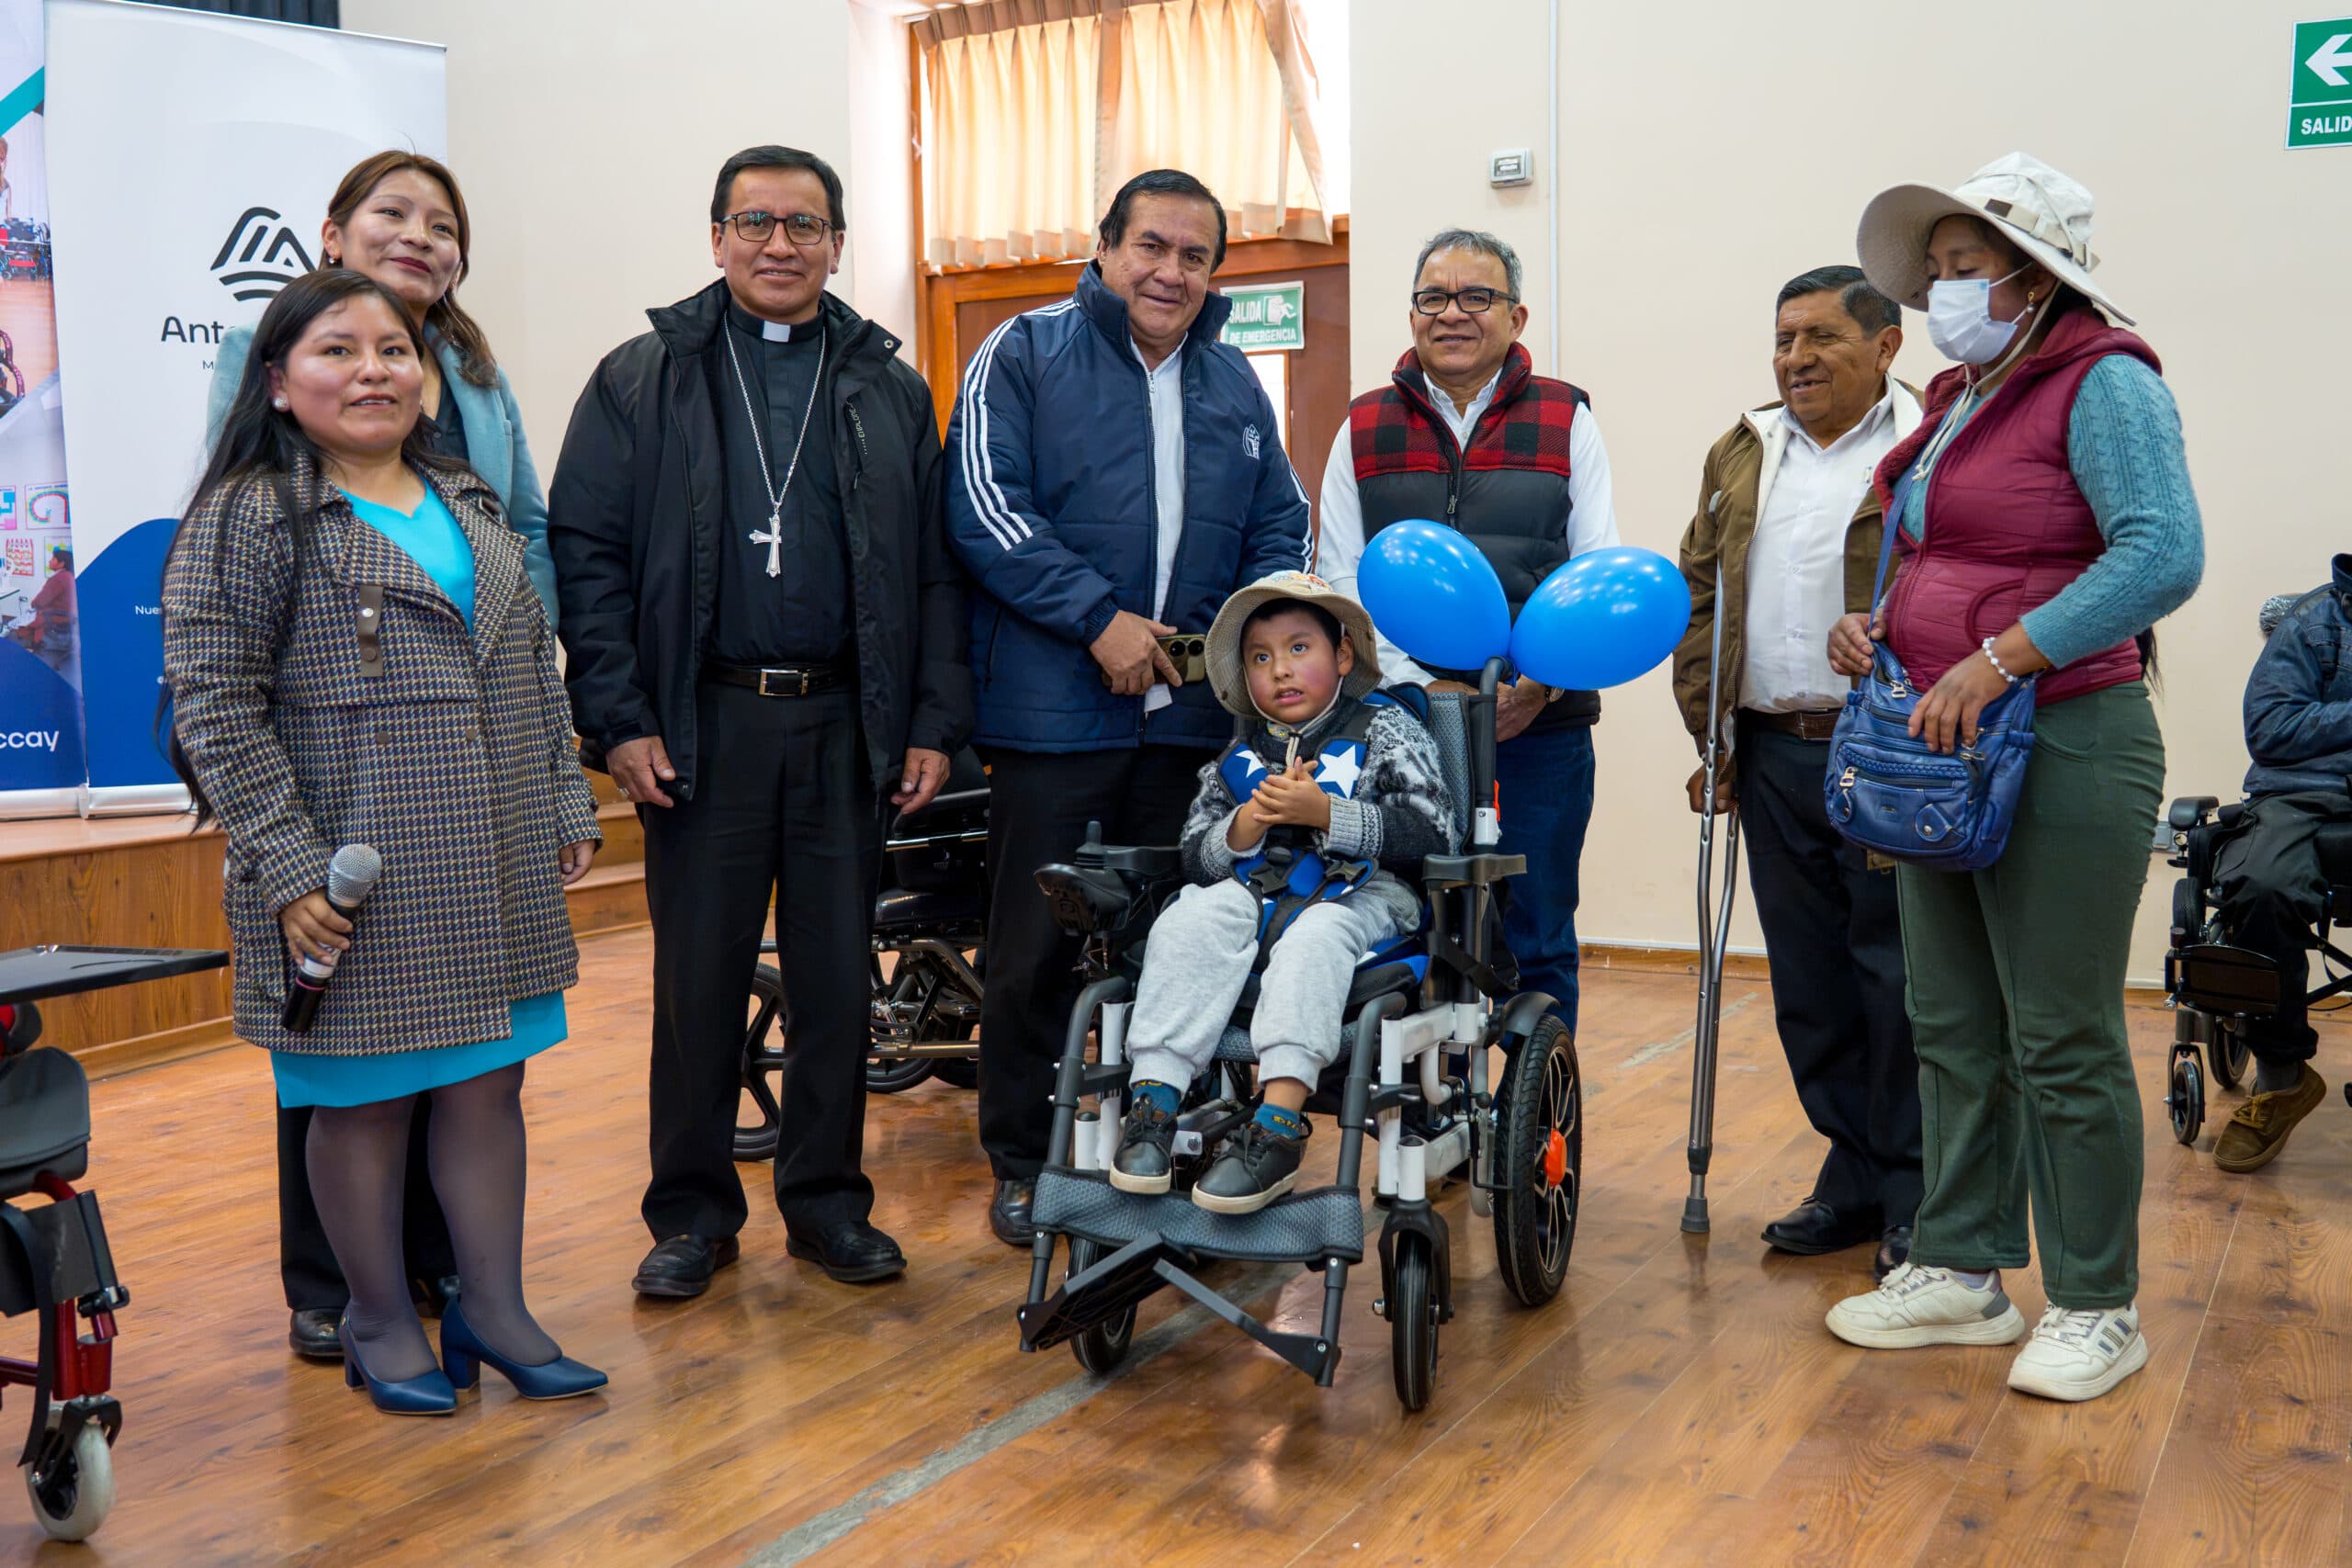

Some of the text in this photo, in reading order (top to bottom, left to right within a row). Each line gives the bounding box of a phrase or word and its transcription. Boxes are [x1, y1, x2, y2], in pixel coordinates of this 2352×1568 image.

[2301, 116, 2352, 135] SALID
[161, 316, 236, 344] Ant
[1242, 328, 1296, 344] EMERGENCIA
